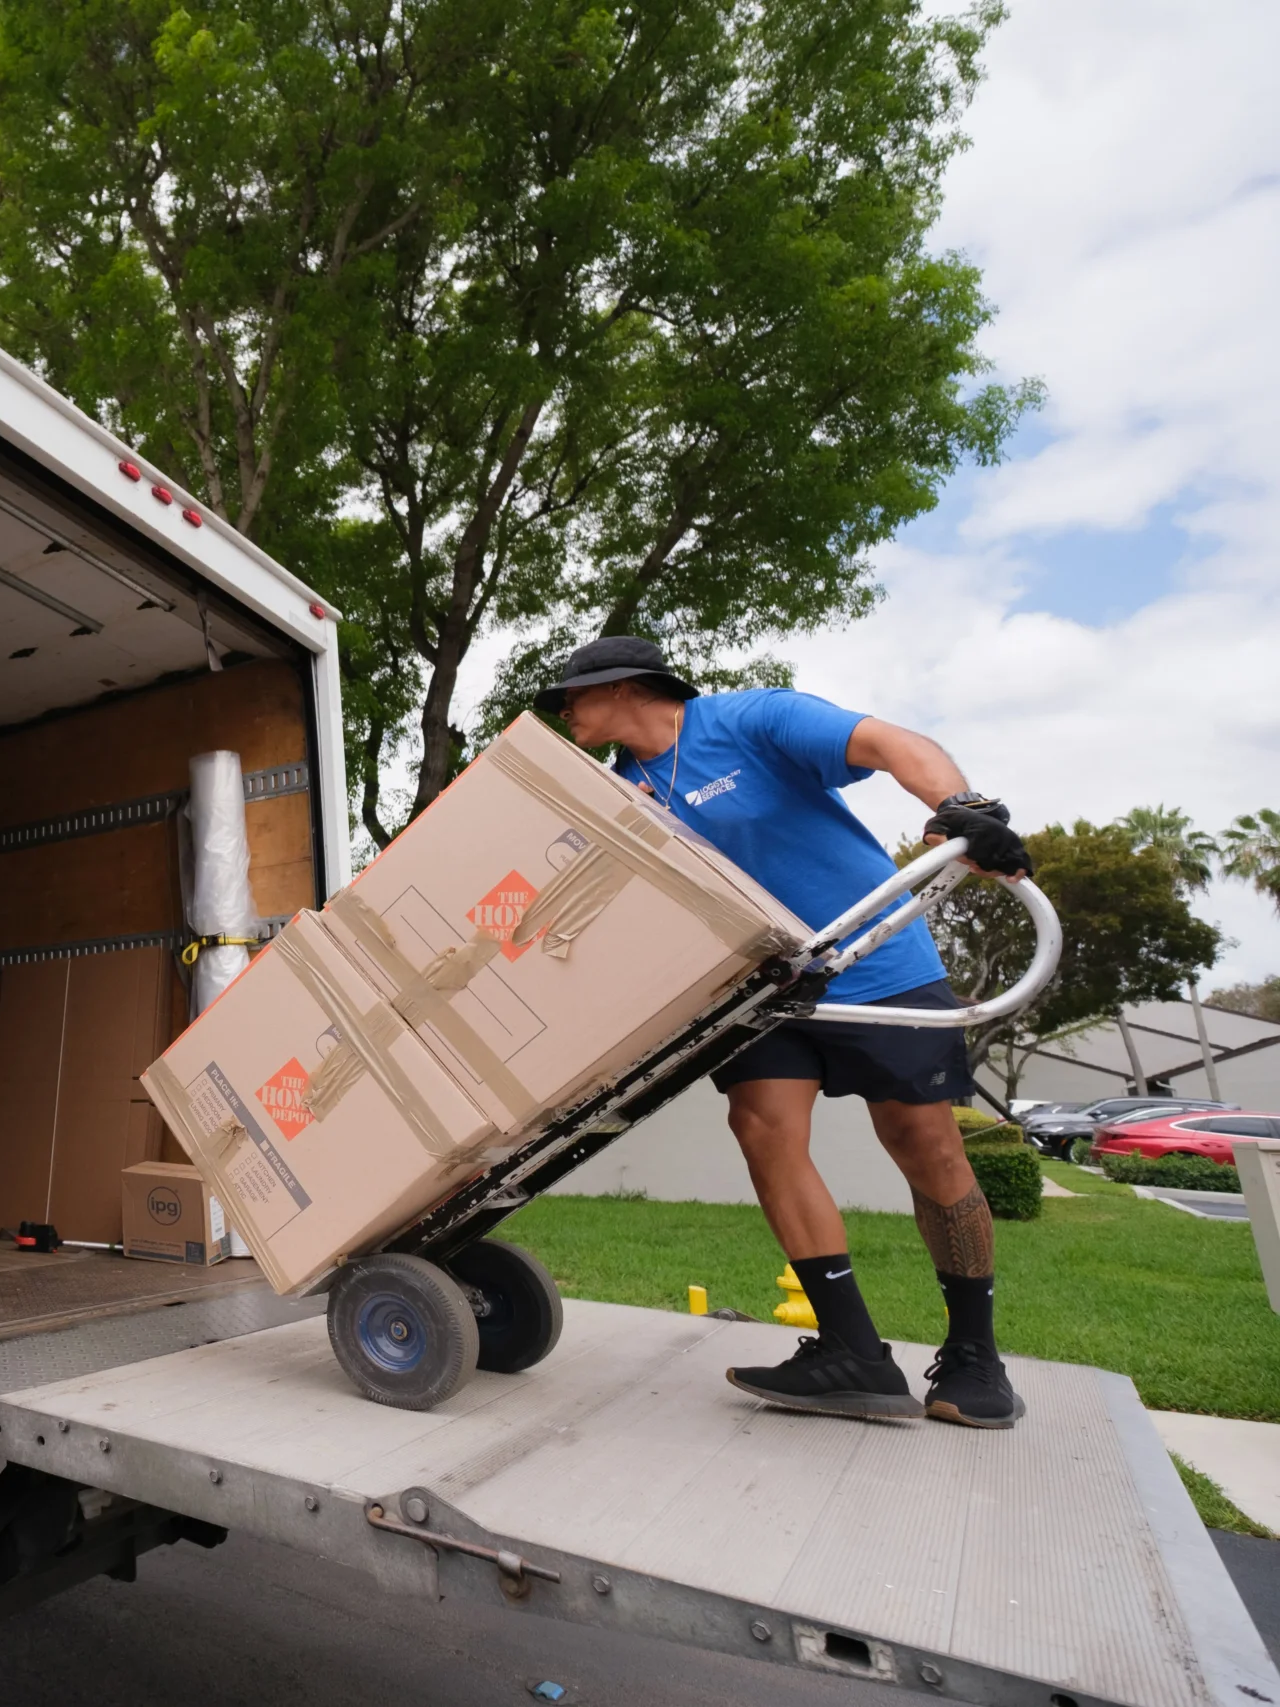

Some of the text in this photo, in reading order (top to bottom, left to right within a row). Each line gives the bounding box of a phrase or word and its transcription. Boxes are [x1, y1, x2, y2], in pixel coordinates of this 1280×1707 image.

[700, 775, 733, 795] LOGISTIC
[702, 781, 737, 802] SERVICES
[565, 831, 587, 851] MOV
[497, 891, 529, 905] THE
[210, 1069, 240, 1109] PLACE IN:
[280, 1074, 306, 1090] THE
[196, 1097, 212, 1119] FAMILY
[206, 1087, 227, 1113] PRIMARY
[190, 1103, 204, 1123] LIVING
[272, 1107, 314, 1125] DEPOT
[250, 1165, 273, 1195] LAUNDRY
[256, 1160, 278, 1188] KITCHEN
[266, 1151, 297, 1190] FRAGILE
[233, 1182, 248, 1200] ATTIC
[239, 1176, 260, 1203] GARAGE
[244, 1171, 270, 1204] BASEMENT
[149, 1196, 179, 1217] ipg
